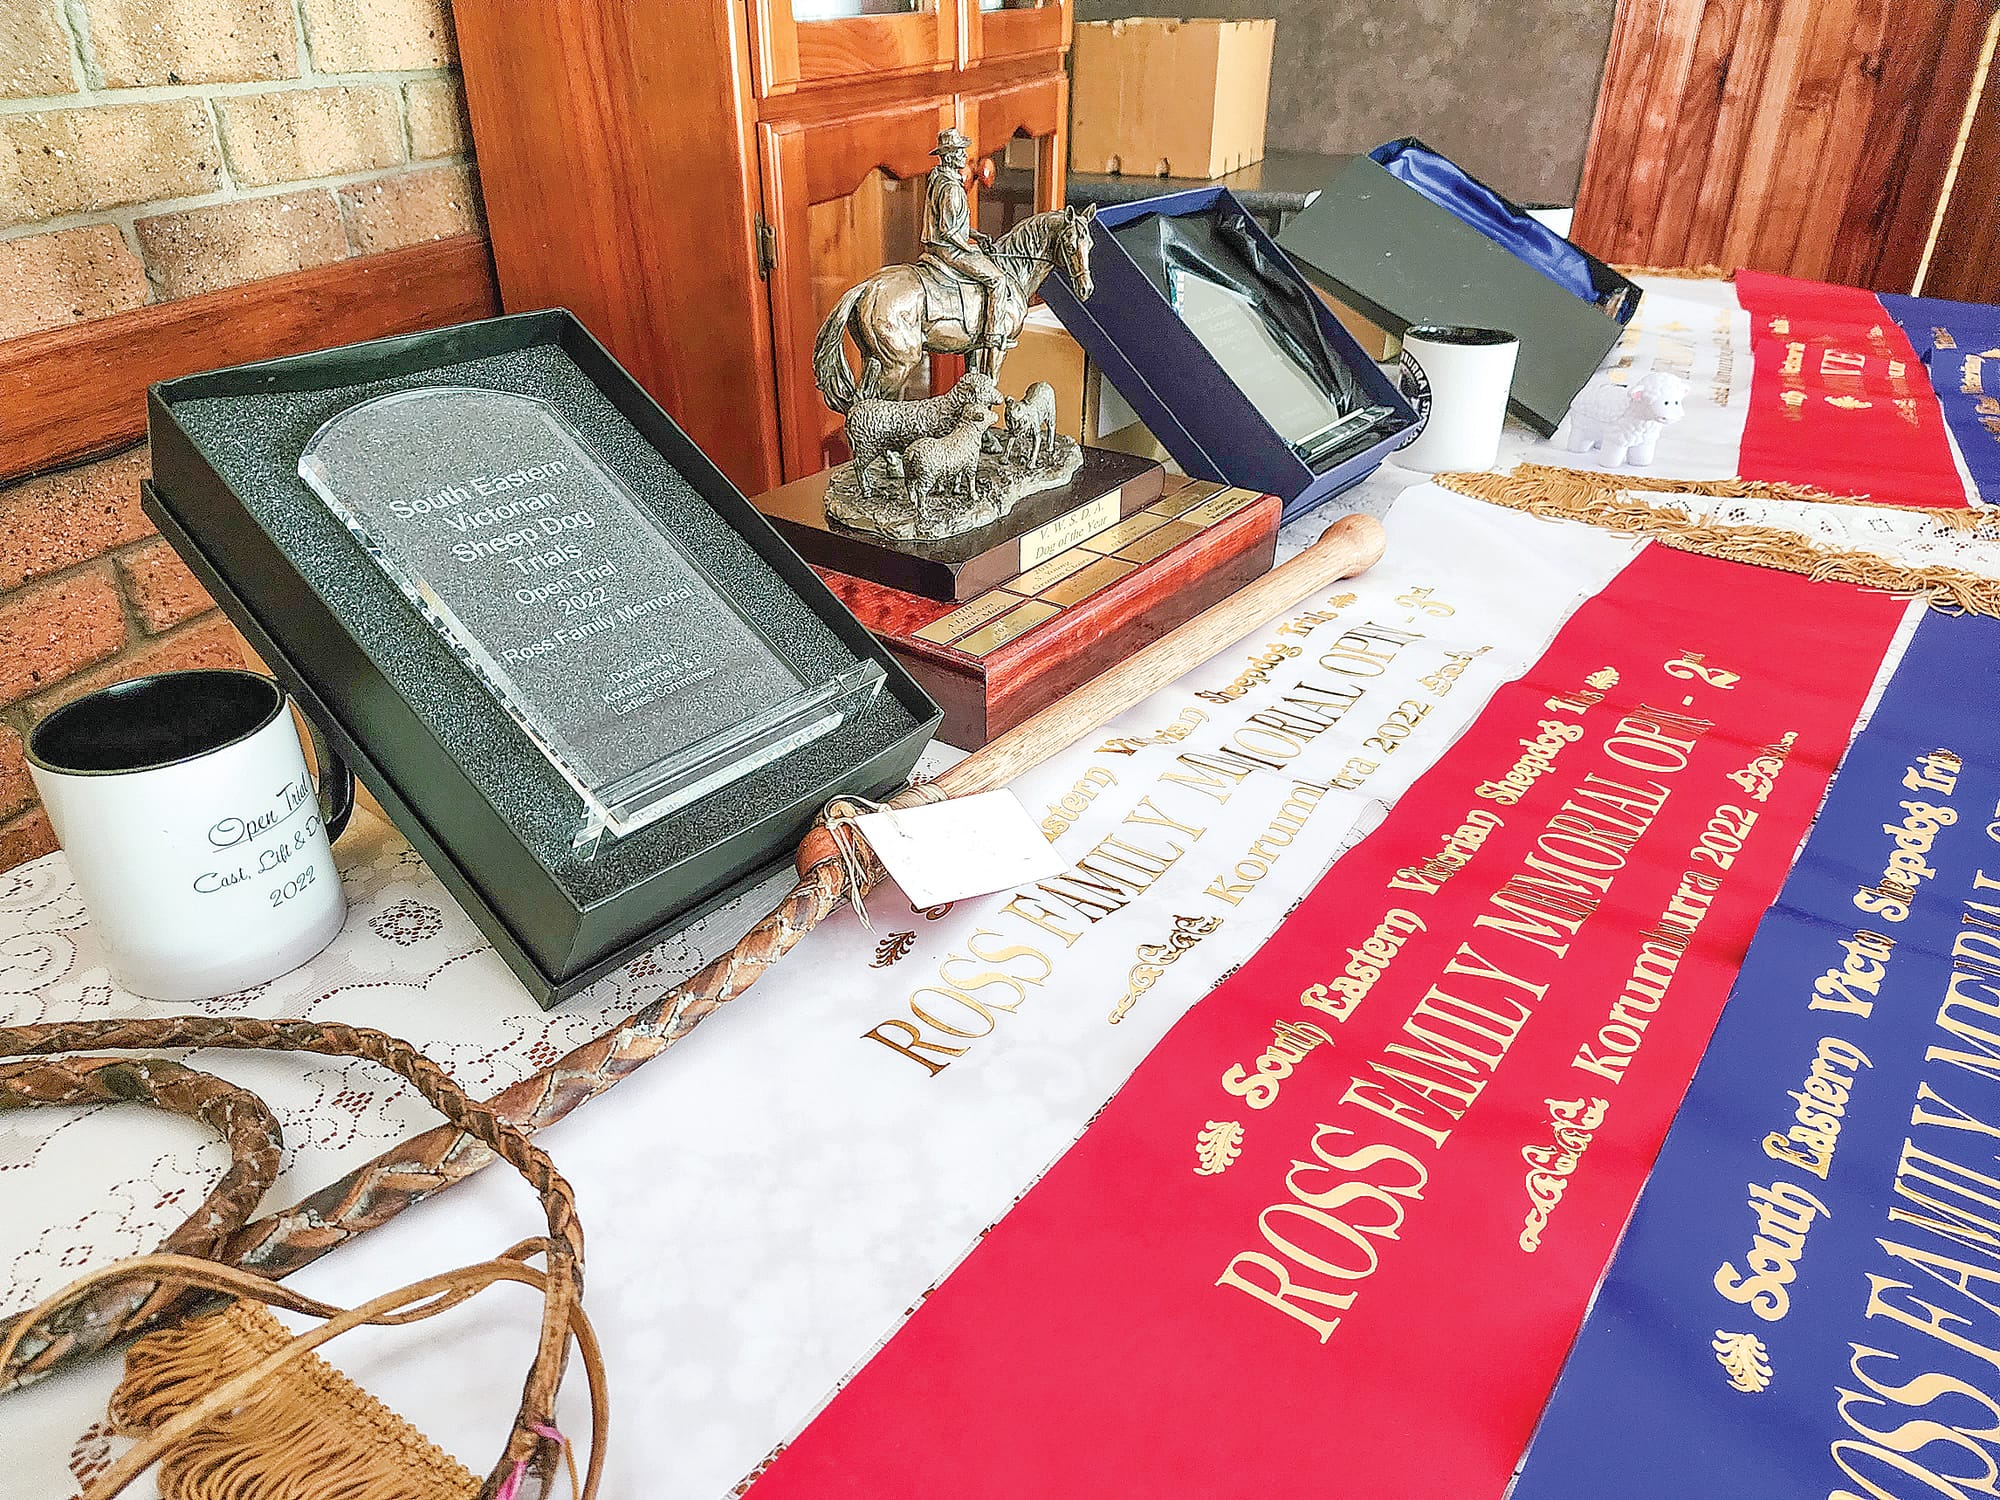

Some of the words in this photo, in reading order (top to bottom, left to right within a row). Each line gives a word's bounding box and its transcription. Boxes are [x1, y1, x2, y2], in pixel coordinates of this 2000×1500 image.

[389, 484, 472, 519] South
[470, 459, 570, 496] Eastern
[443, 490, 559, 532] Victorian
[452, 527, 540, 563] Sheep
[538, 510, 595, 536] Dog
[506, 544, 583, 575] Trials
[1035, 543, 1056, 560] Dog
[1058, 532, 1070, 548] of
[1070, 528, 1084, 542] the
[1087, 516, 1108, 533] Year
[514, 577, 574, 605] Open
[572, 558, 620, 584] Trial
[558, 586, 613, 616] 2022
[502, 637, 556, 665] Ross
[553, 614, 616, 645] Family
[615, 583, 696, 624] Memorial
[948, 605, 972, 618] 2010
[955, 603, 994, 624] Dickson
[601, 670, 673, 705] Korumburra
[671, 663, 684, 675] A
[682, 658, 693, 669] &
[610, 655, 661, 683] Donated
[660, 650, 679, 665] by
[612, 693, 655, 716] Ladies
[654, 667, 716, 698] Committee
[1194, 641, 1303, 704] Sheepdog
[1363, 700, 1433, 754] 2022
[208, 810, 279, 847] Open
[276, 772, 310, 811] Trial
[194, 867, 251, 893] Cast,
[258, 844, 292, 874] Lift
[294, 831, 305, 850] &
[269, 865, 316, 908] 2022
[1852, 799, 1959, 923] Sheepdog
[859, 928, 1052, 1077] ROSS
[998, 795, 1207, 948] FAMILY
[1222, 1020, 1335, 1109] South
[1300, 909, 1428, 1022] Eastern
[1387, 808, 1505, 896] Victorian
[1475, 719, 1585, 806] Sheepdog
[1571, 870, 1723, 1085] Korumburra
[1690, 804, 1759, 871] 2022
[1762, 1036, 1874, 1180] Eastern
[1214, 1123, 1429, 1345] ROSS
[1337, 941, 1550, 1150] FAMILY
[1714, 1181, 1832, 1322] South
